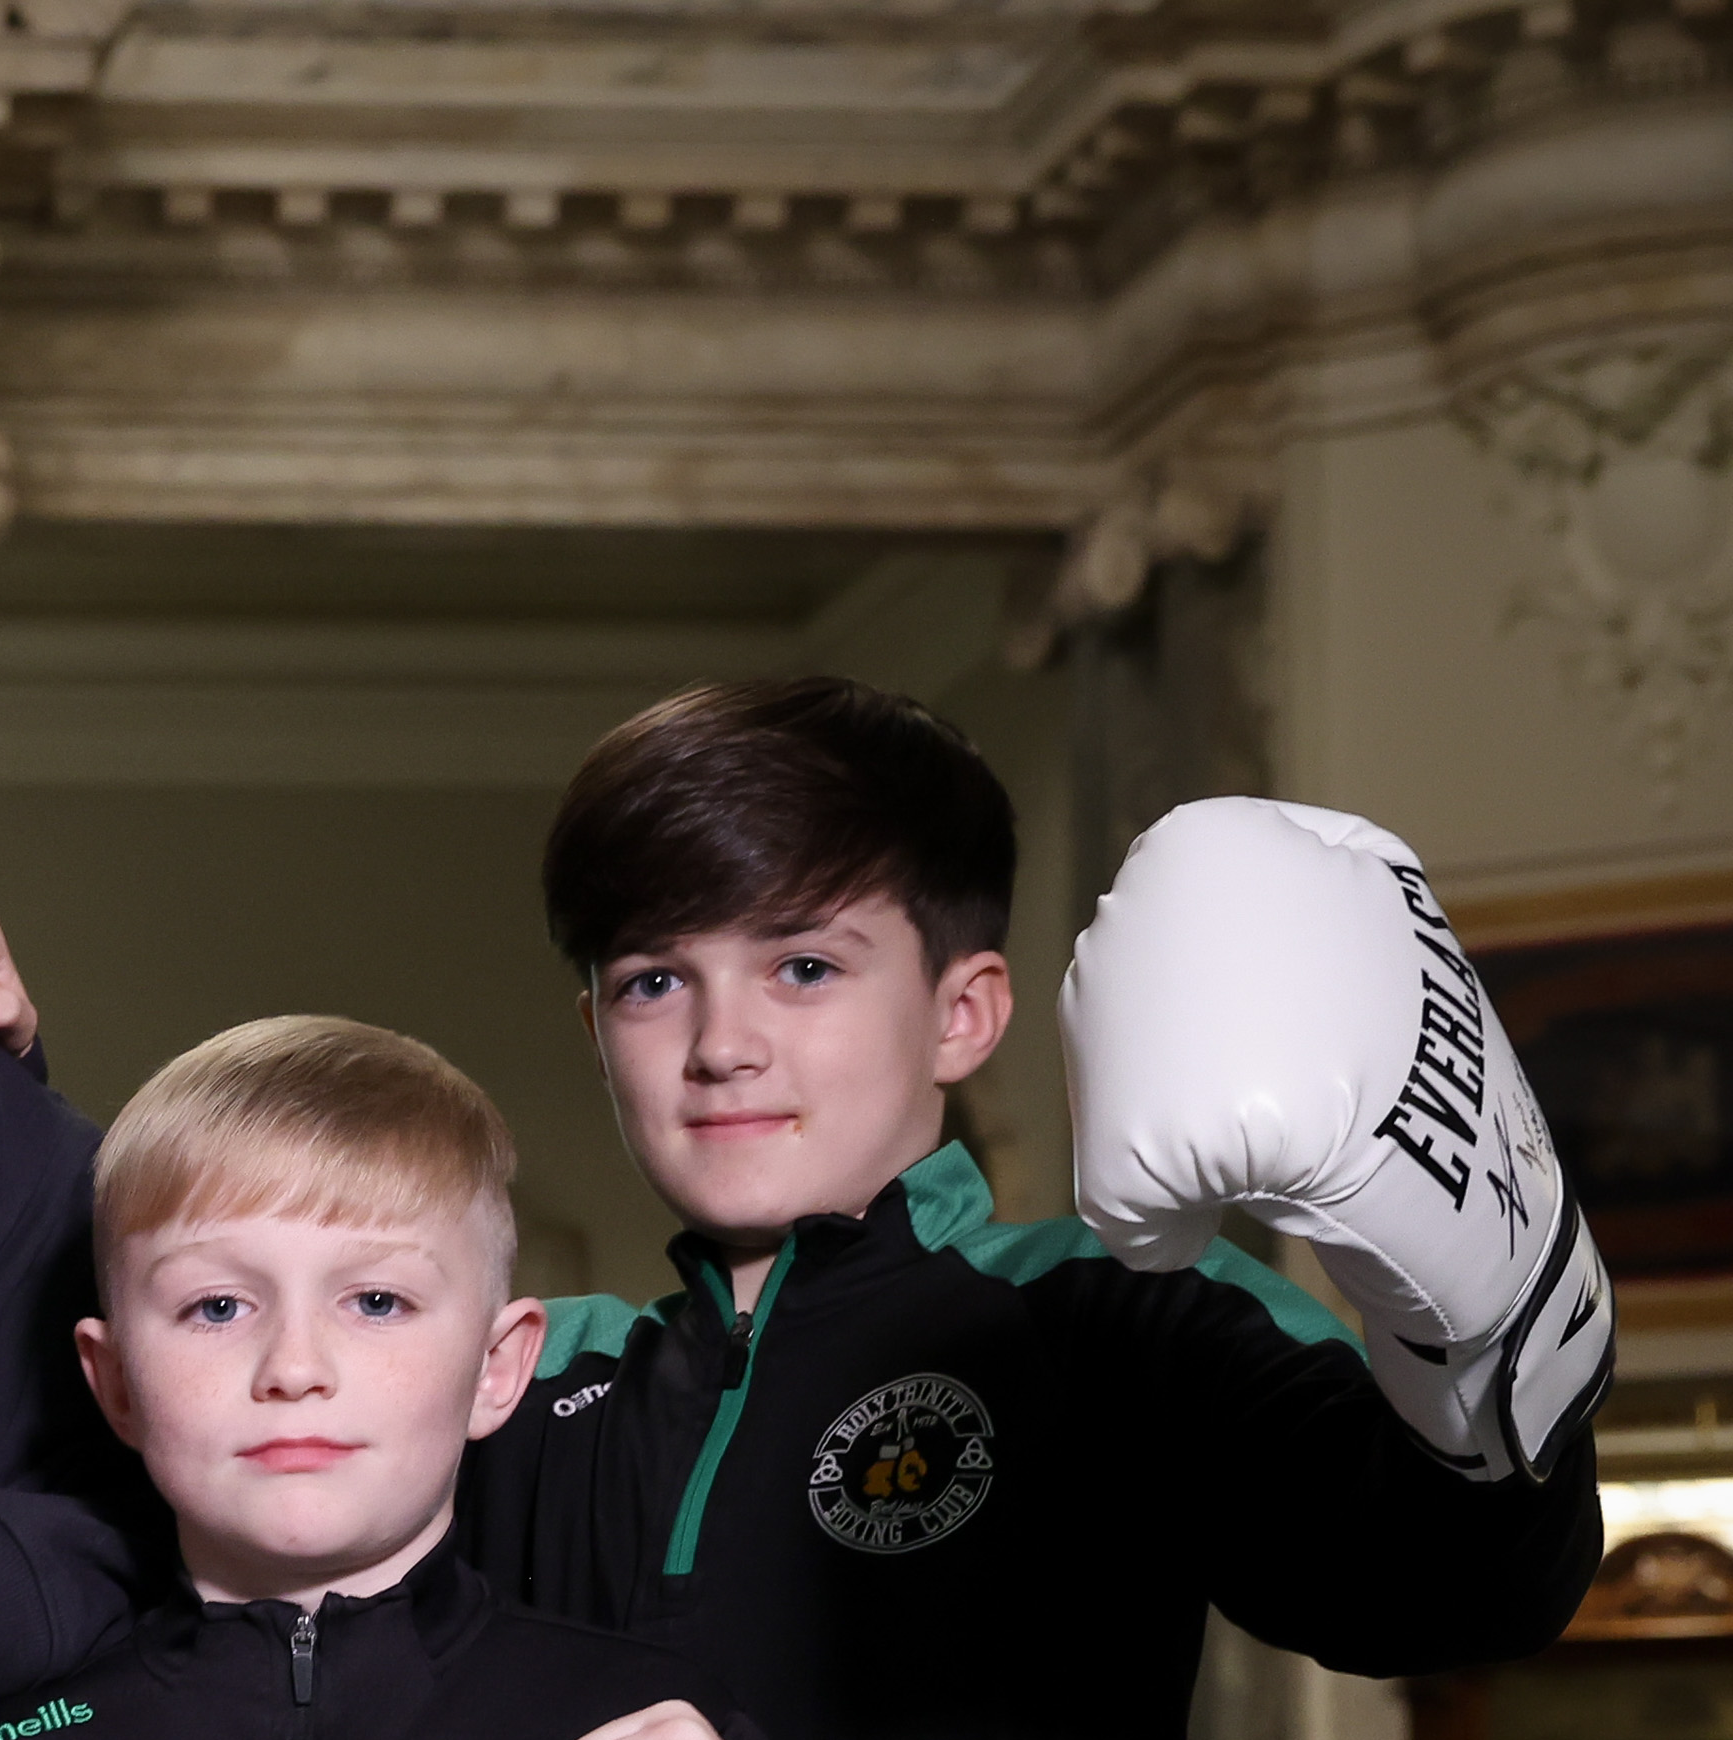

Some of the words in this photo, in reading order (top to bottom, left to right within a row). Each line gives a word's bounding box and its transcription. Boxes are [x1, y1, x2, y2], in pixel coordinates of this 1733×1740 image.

[836, 1394, 887, 1442] HOLY
[893, 1379, 974, 1424] TRINITY
[823, 1501, 903, 1546] BOXING
[920, 1483, 975, 1534] CLUB
